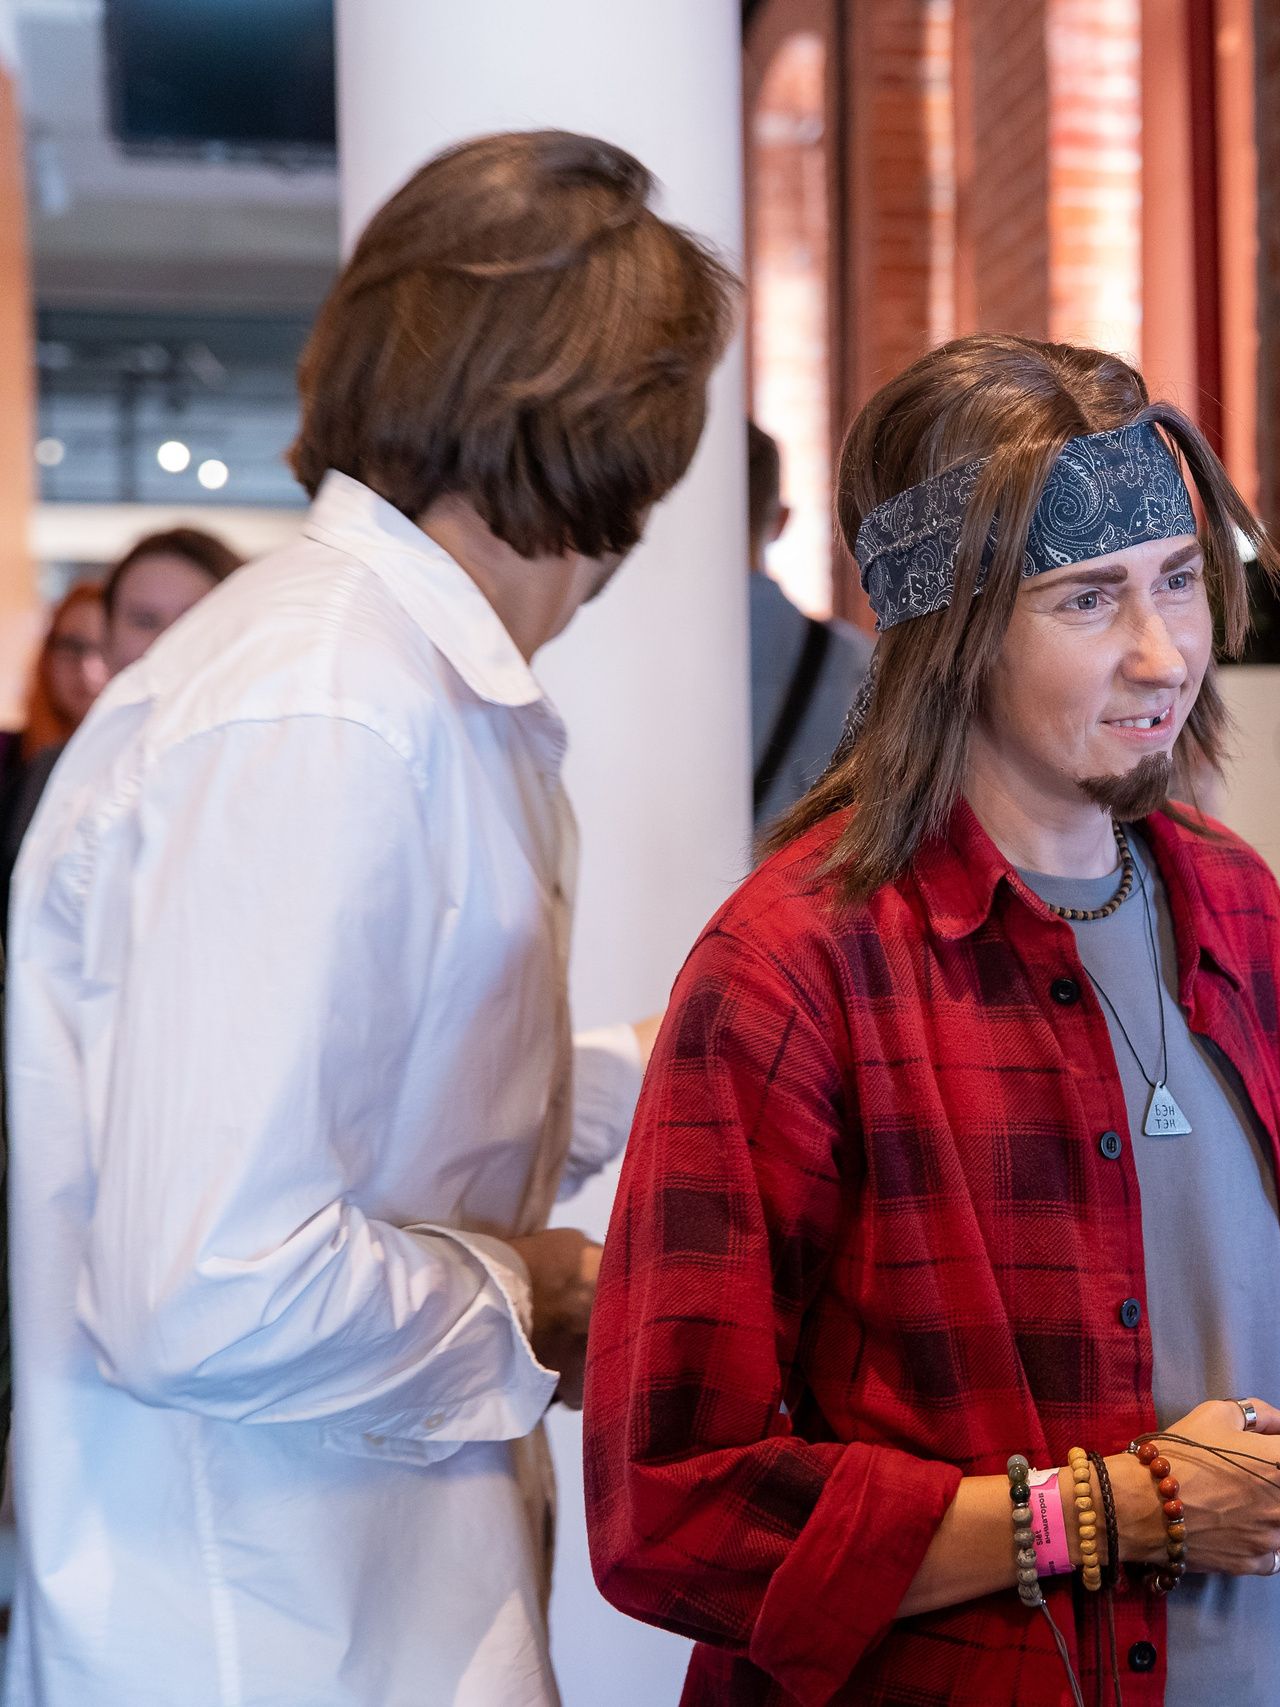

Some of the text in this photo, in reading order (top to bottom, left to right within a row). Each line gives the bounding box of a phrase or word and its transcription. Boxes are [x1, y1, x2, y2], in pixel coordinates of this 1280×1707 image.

[1154, 1104, 1175, 1117] БЭН
[1154, 1119, 1176, 1129] ТЭН
[1038, 1492, 1051, 1544] аниматоров
